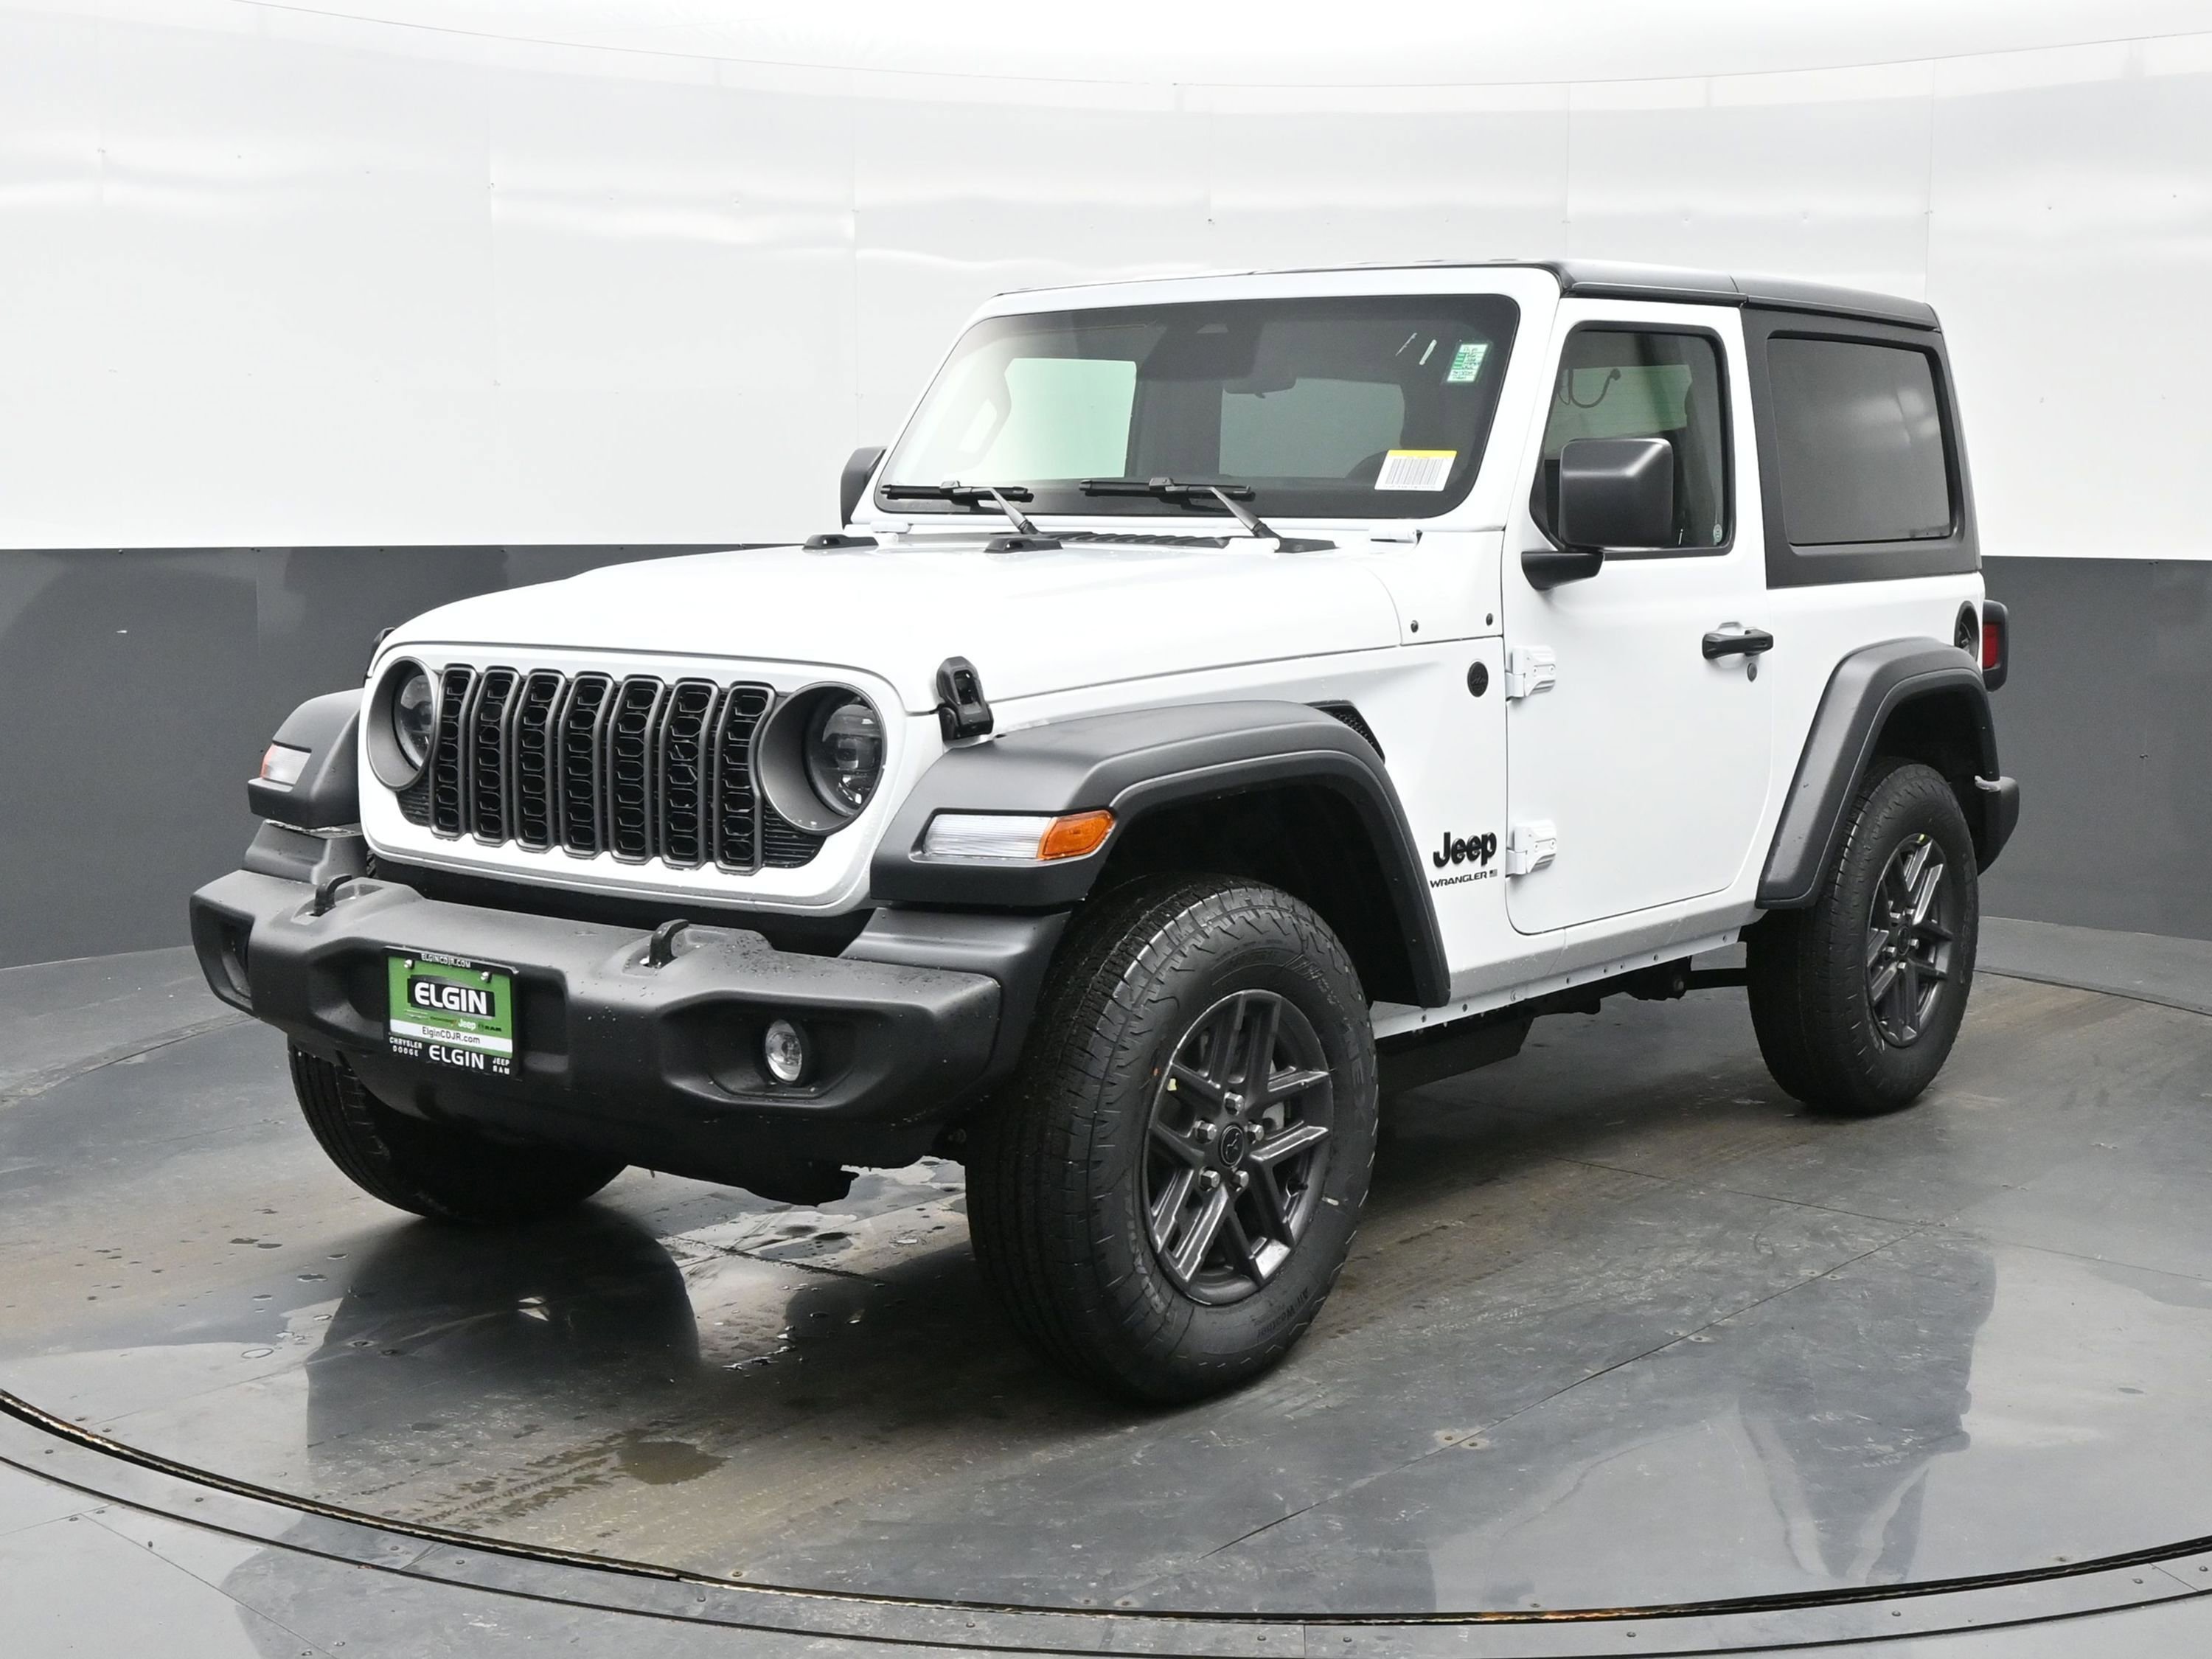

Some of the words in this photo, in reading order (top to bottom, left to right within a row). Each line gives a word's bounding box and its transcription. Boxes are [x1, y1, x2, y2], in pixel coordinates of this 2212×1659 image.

[1433, 831, 1497, 868] Jeep
[1430, 871, 1487, 888] WRANGLER
[420, 953, 471, 967] ELGINCDJR.COM
[414, 982, 487, 1015] ELGIN
[458, 1018, 476, 1030] Jeep
[422, 1026, 481, 1044] ElginCDJR.com
[389, 1037, 422, 1049] CHRYSLER
[393, 1046, 419, 1057] DODGE
[429, 1045, 484, 1069] ELGIN
[493, 1057, 510, 1065] JEEP
[493, 1065, 510, 1074] RAM
